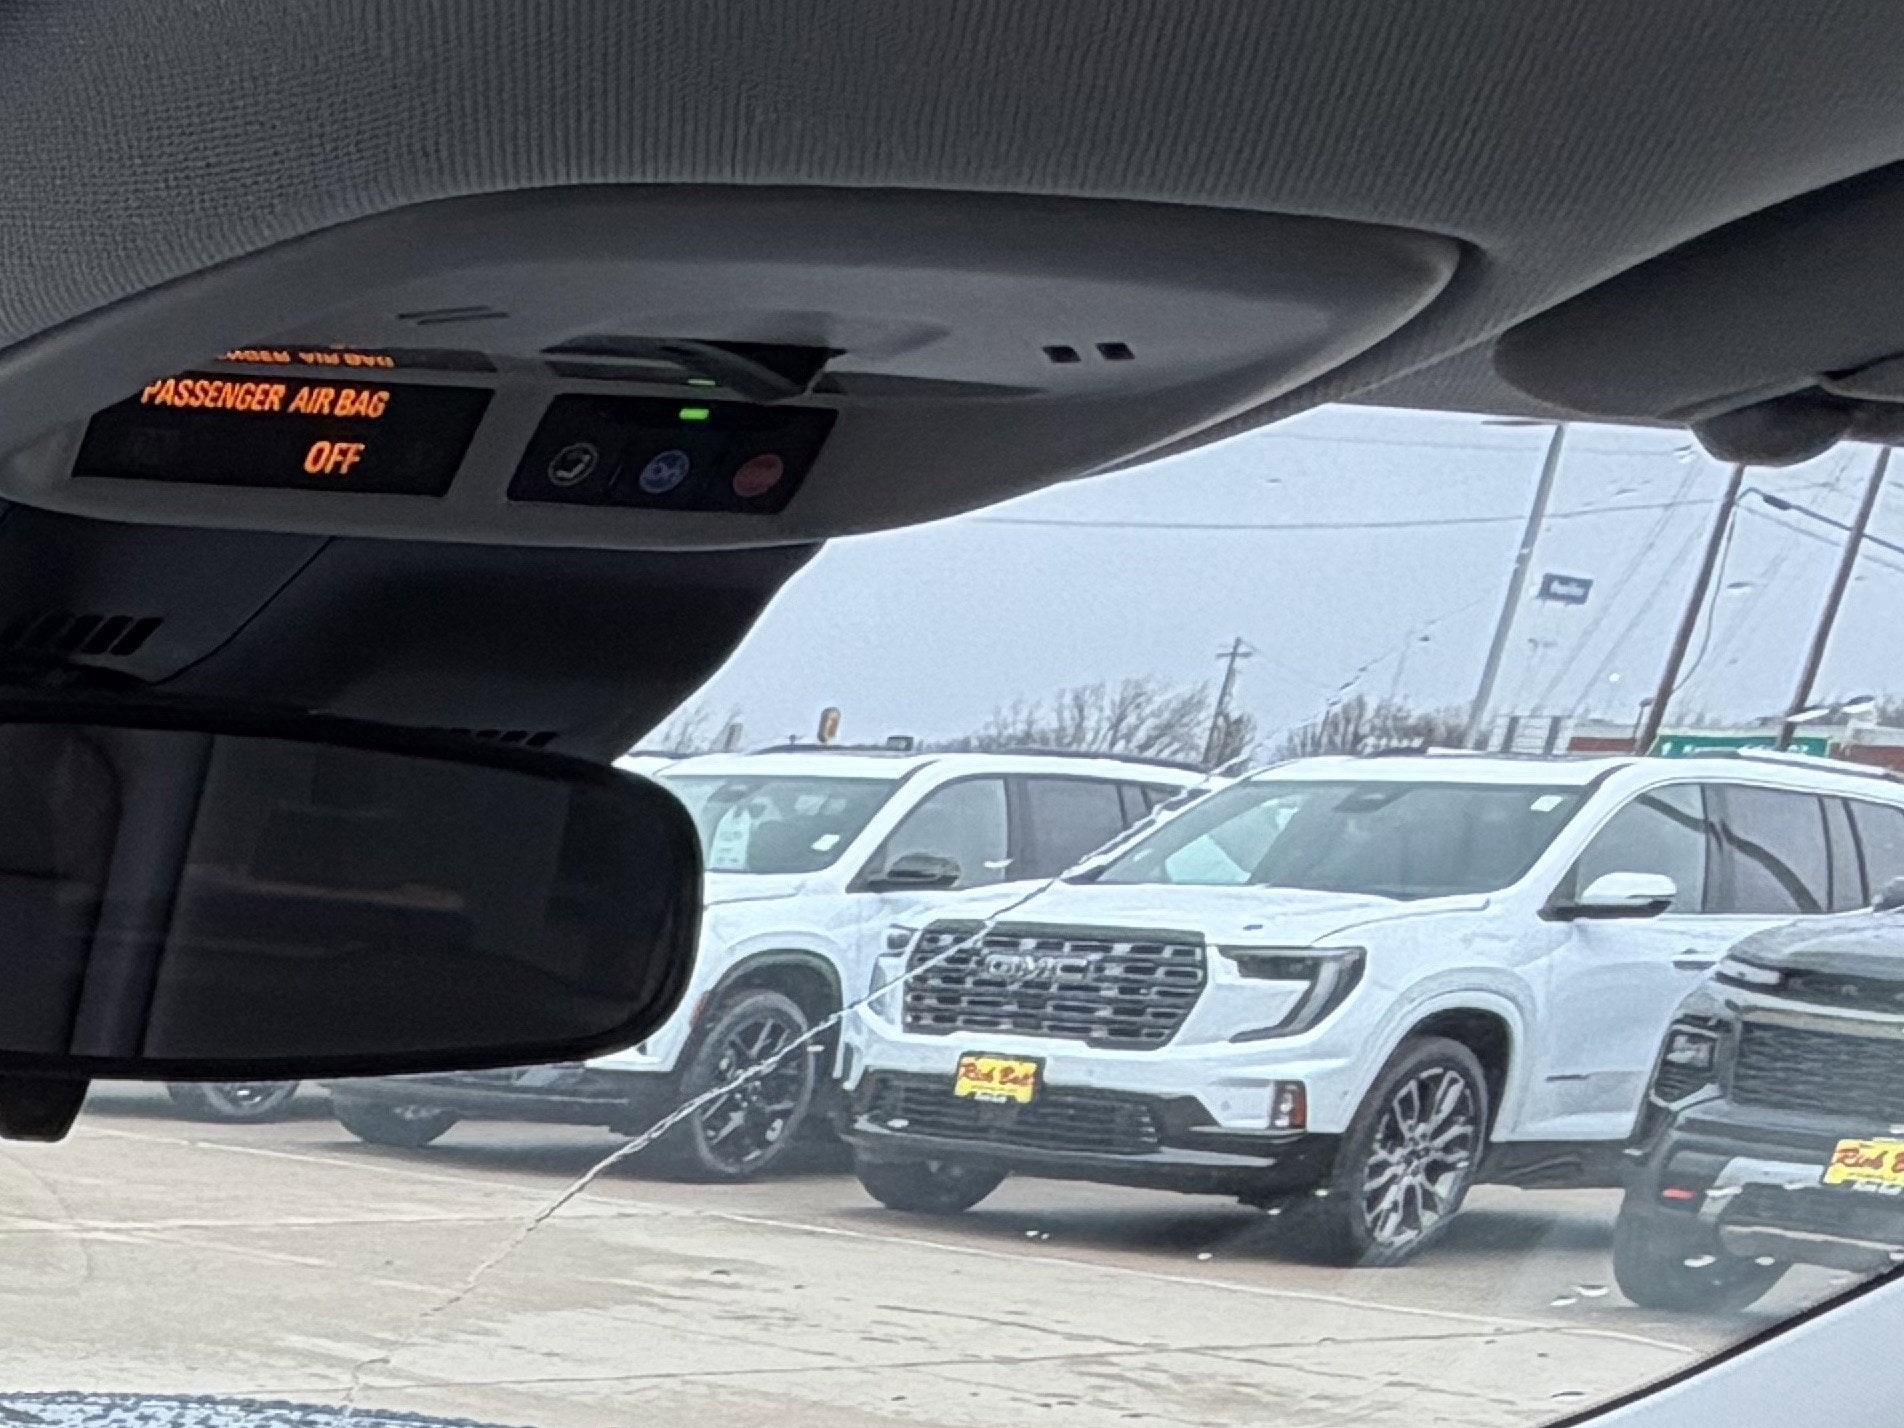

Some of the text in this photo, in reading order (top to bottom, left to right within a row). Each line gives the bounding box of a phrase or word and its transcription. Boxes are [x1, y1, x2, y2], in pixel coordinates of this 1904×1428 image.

[141, 378, 391, 419] PASSENGER AIR BAG
[304, 441, 365, 475] OFF
